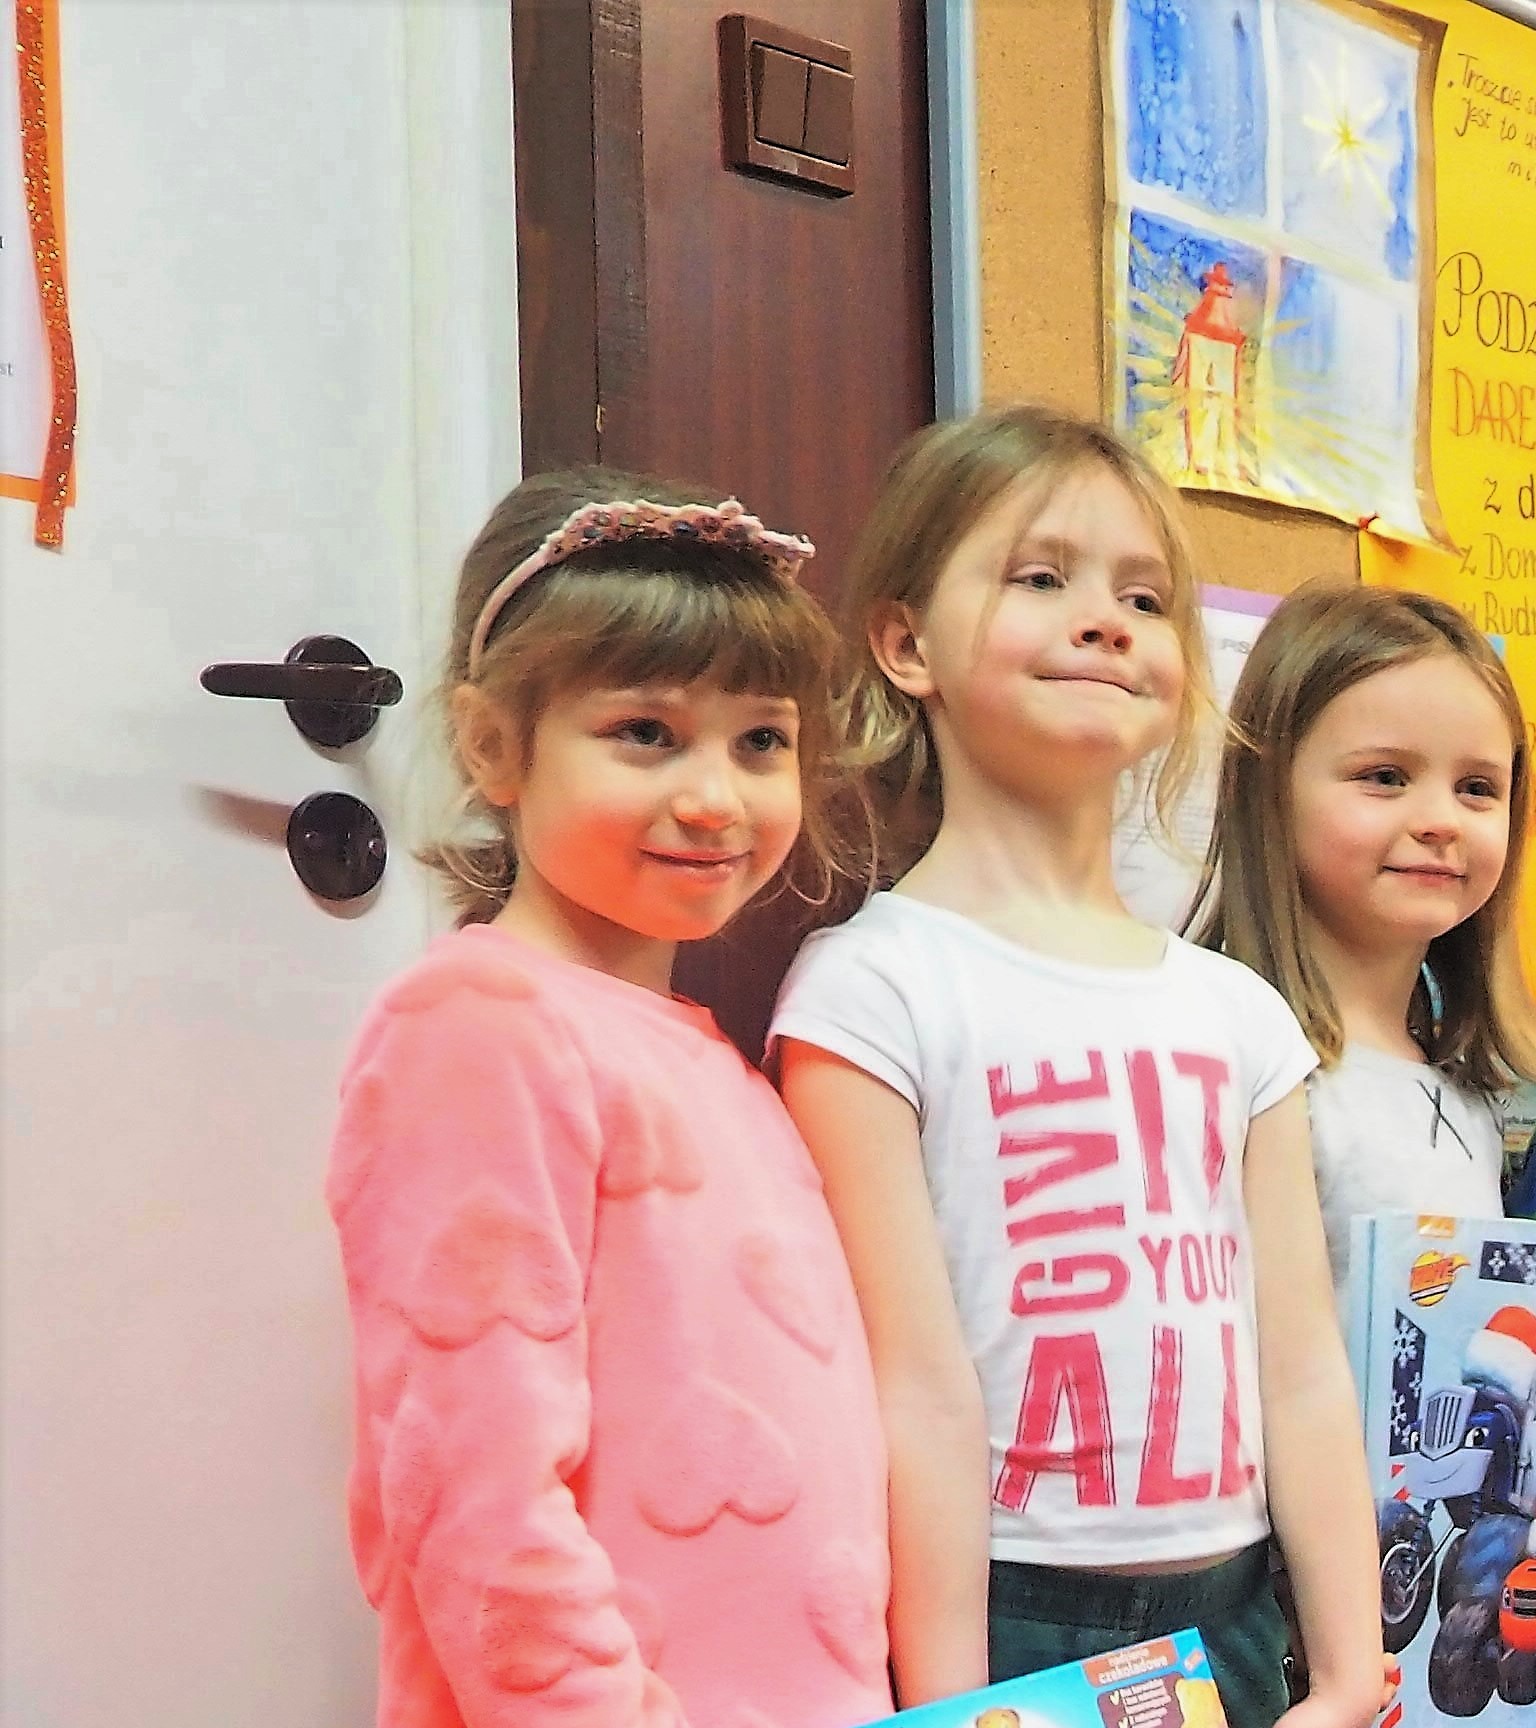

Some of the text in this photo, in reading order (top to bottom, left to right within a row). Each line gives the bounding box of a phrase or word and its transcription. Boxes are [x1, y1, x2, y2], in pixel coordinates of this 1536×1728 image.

[985, 1049, 1131, 1318] GIVE
[1123, 1048, 1230, 1215] IT
[992, 1320, 1256, 1514] ALL
